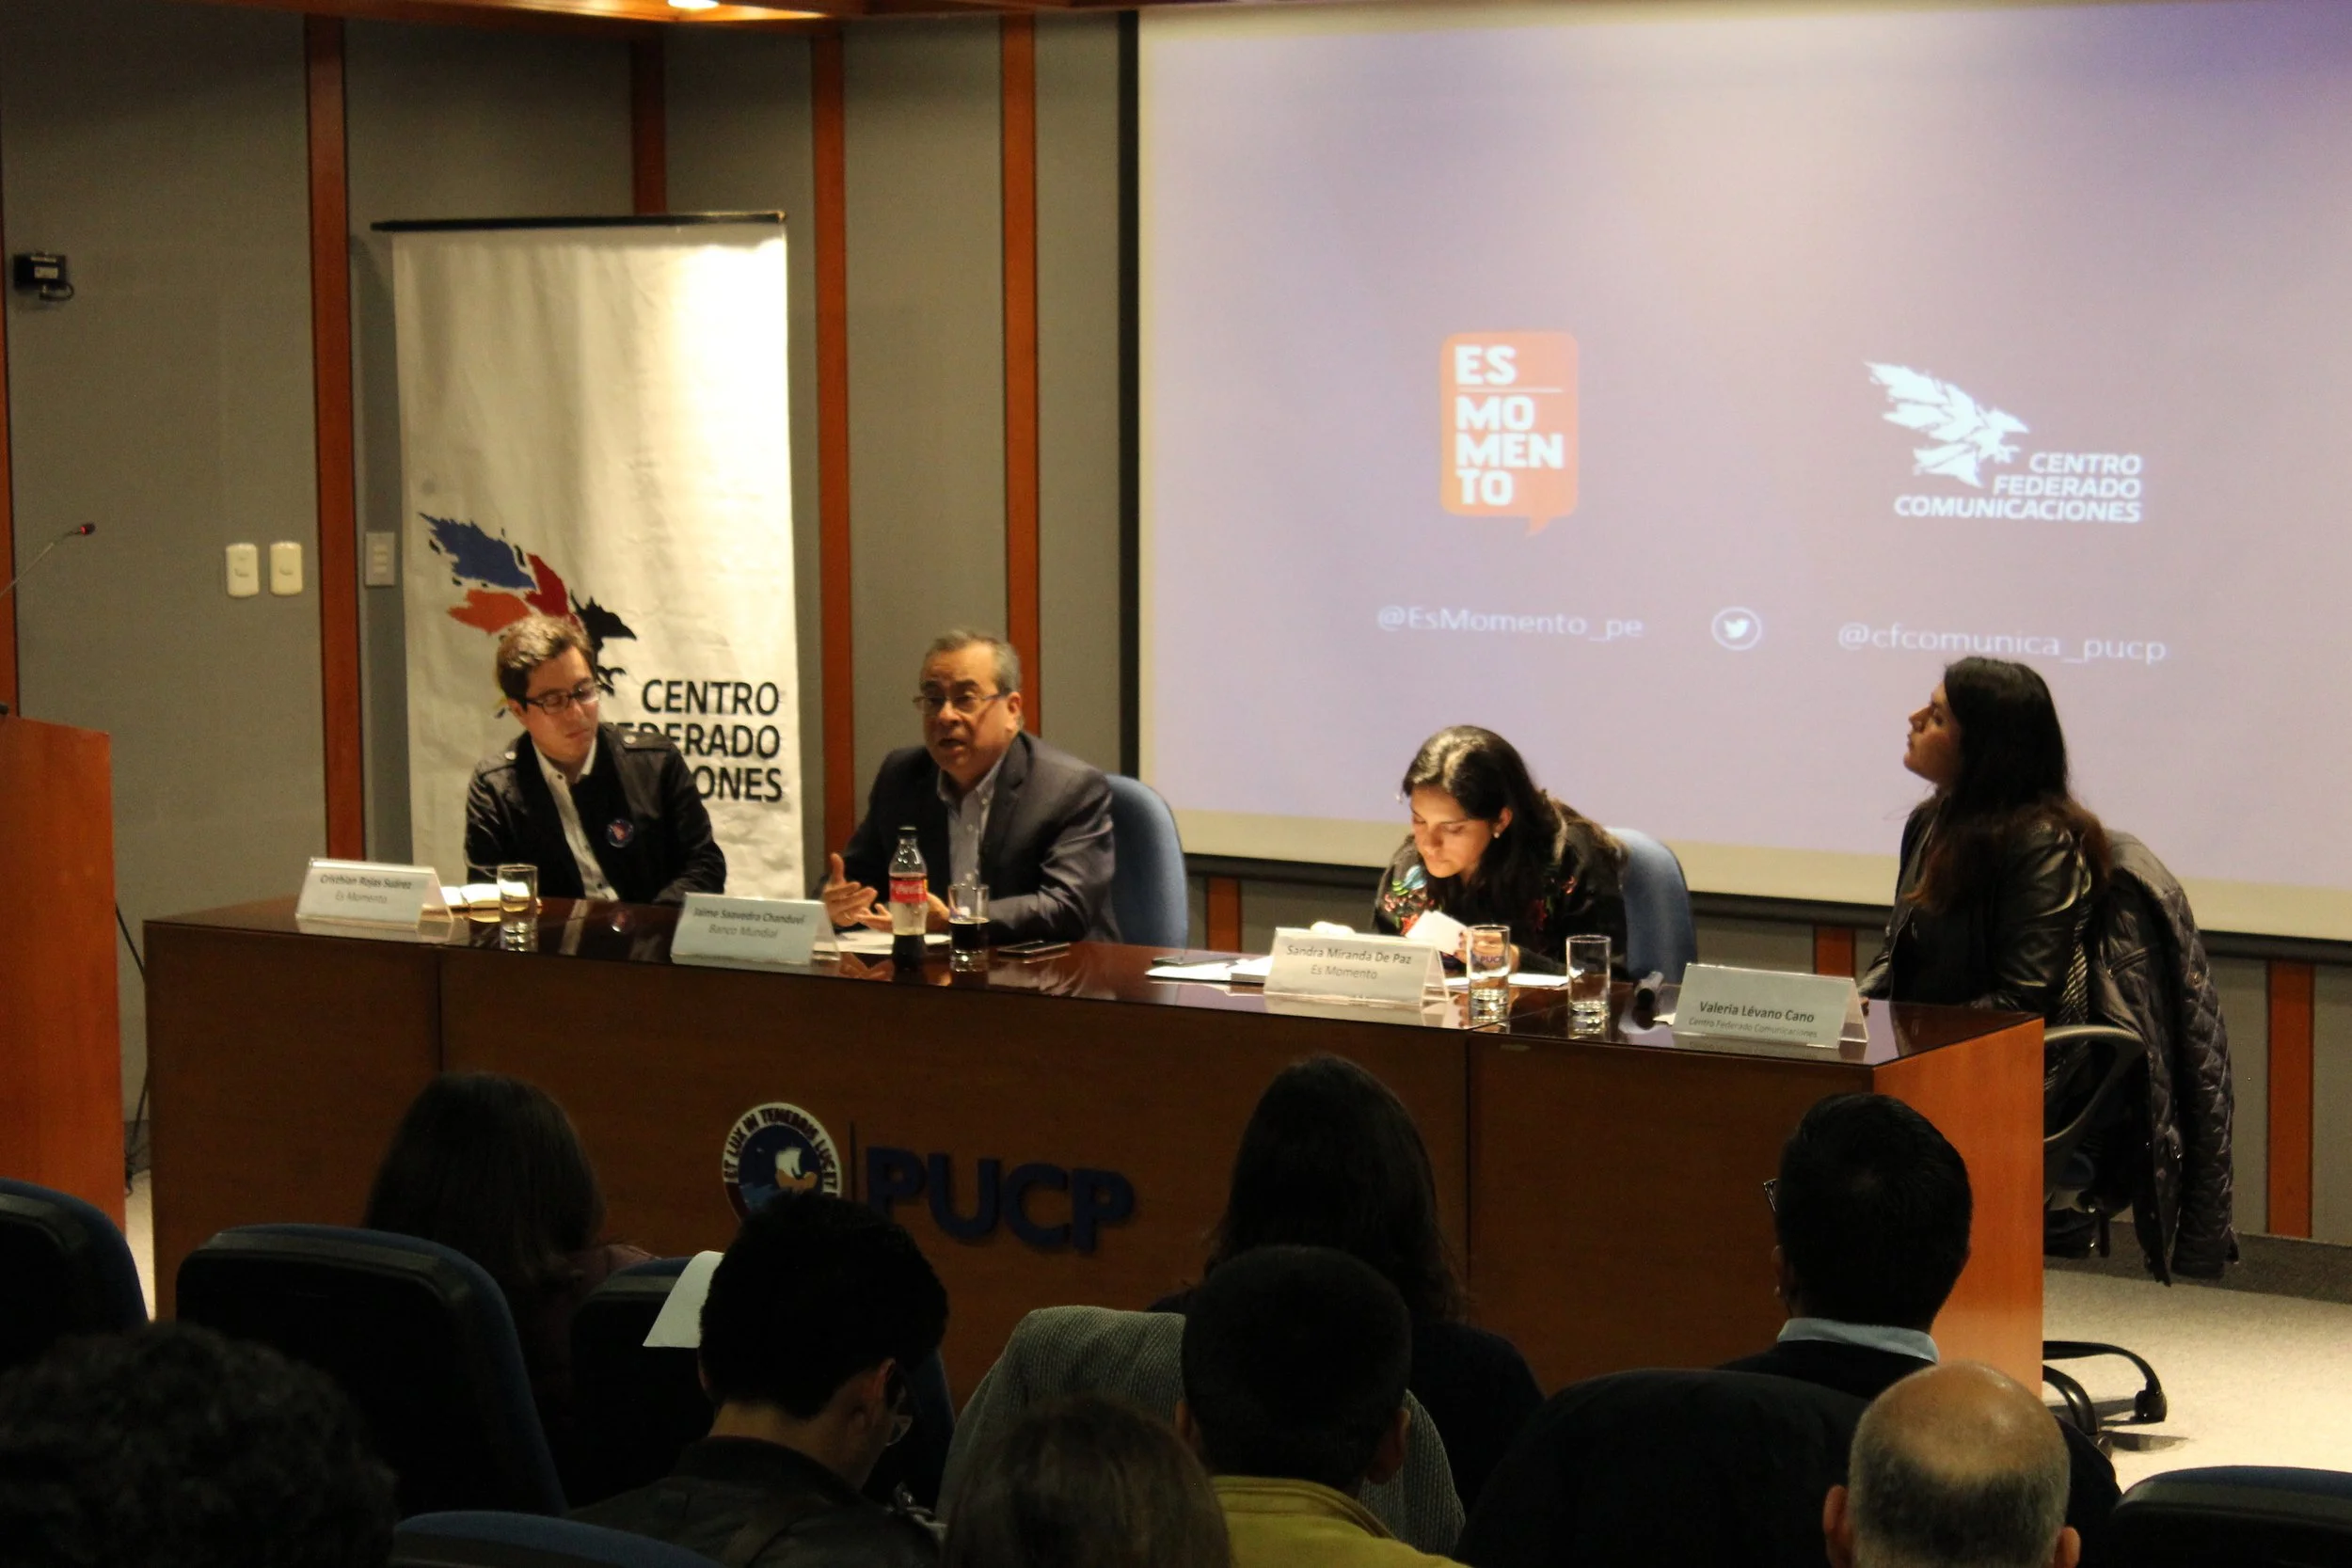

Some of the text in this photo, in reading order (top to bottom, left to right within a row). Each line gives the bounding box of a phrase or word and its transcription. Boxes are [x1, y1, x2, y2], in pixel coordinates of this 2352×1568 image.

[1454, 344, 1517, 386] ES
[1454, 395, 1534, 432] MO
[1454, 432, 1565, 468] MEN
[2028, 451, 2143, 475] CENTRO
[1454, 468, 1514, 506] TO
[1992, 474, 2142, 499] FEDERADO
[1893, 495, 2141, 524] COMUNICACIONES
[1376, 605, 1644, 641] @EsMomento_pe
[1836, 622, 2168, 665] @cfcomunica_pucp
[642, 679, 780, 716] CENTRO
[693, 906, 719, 918] Jaime
[721, 909, 761, 922] Saavedra
[708, 924, 779, 939] Banco Mundial
[1286, 944, 1412, 965] Sandra Miranda De Paz
[1311, 964, 1378, 980] Es Momento
[1699, 1000, 1815, 1023] Valeria Lévano Cano
[1689, 1017, 1818, 1038] Centro Federado Comunicaciones
[866, 1146, 1136, 1255] PUCP
